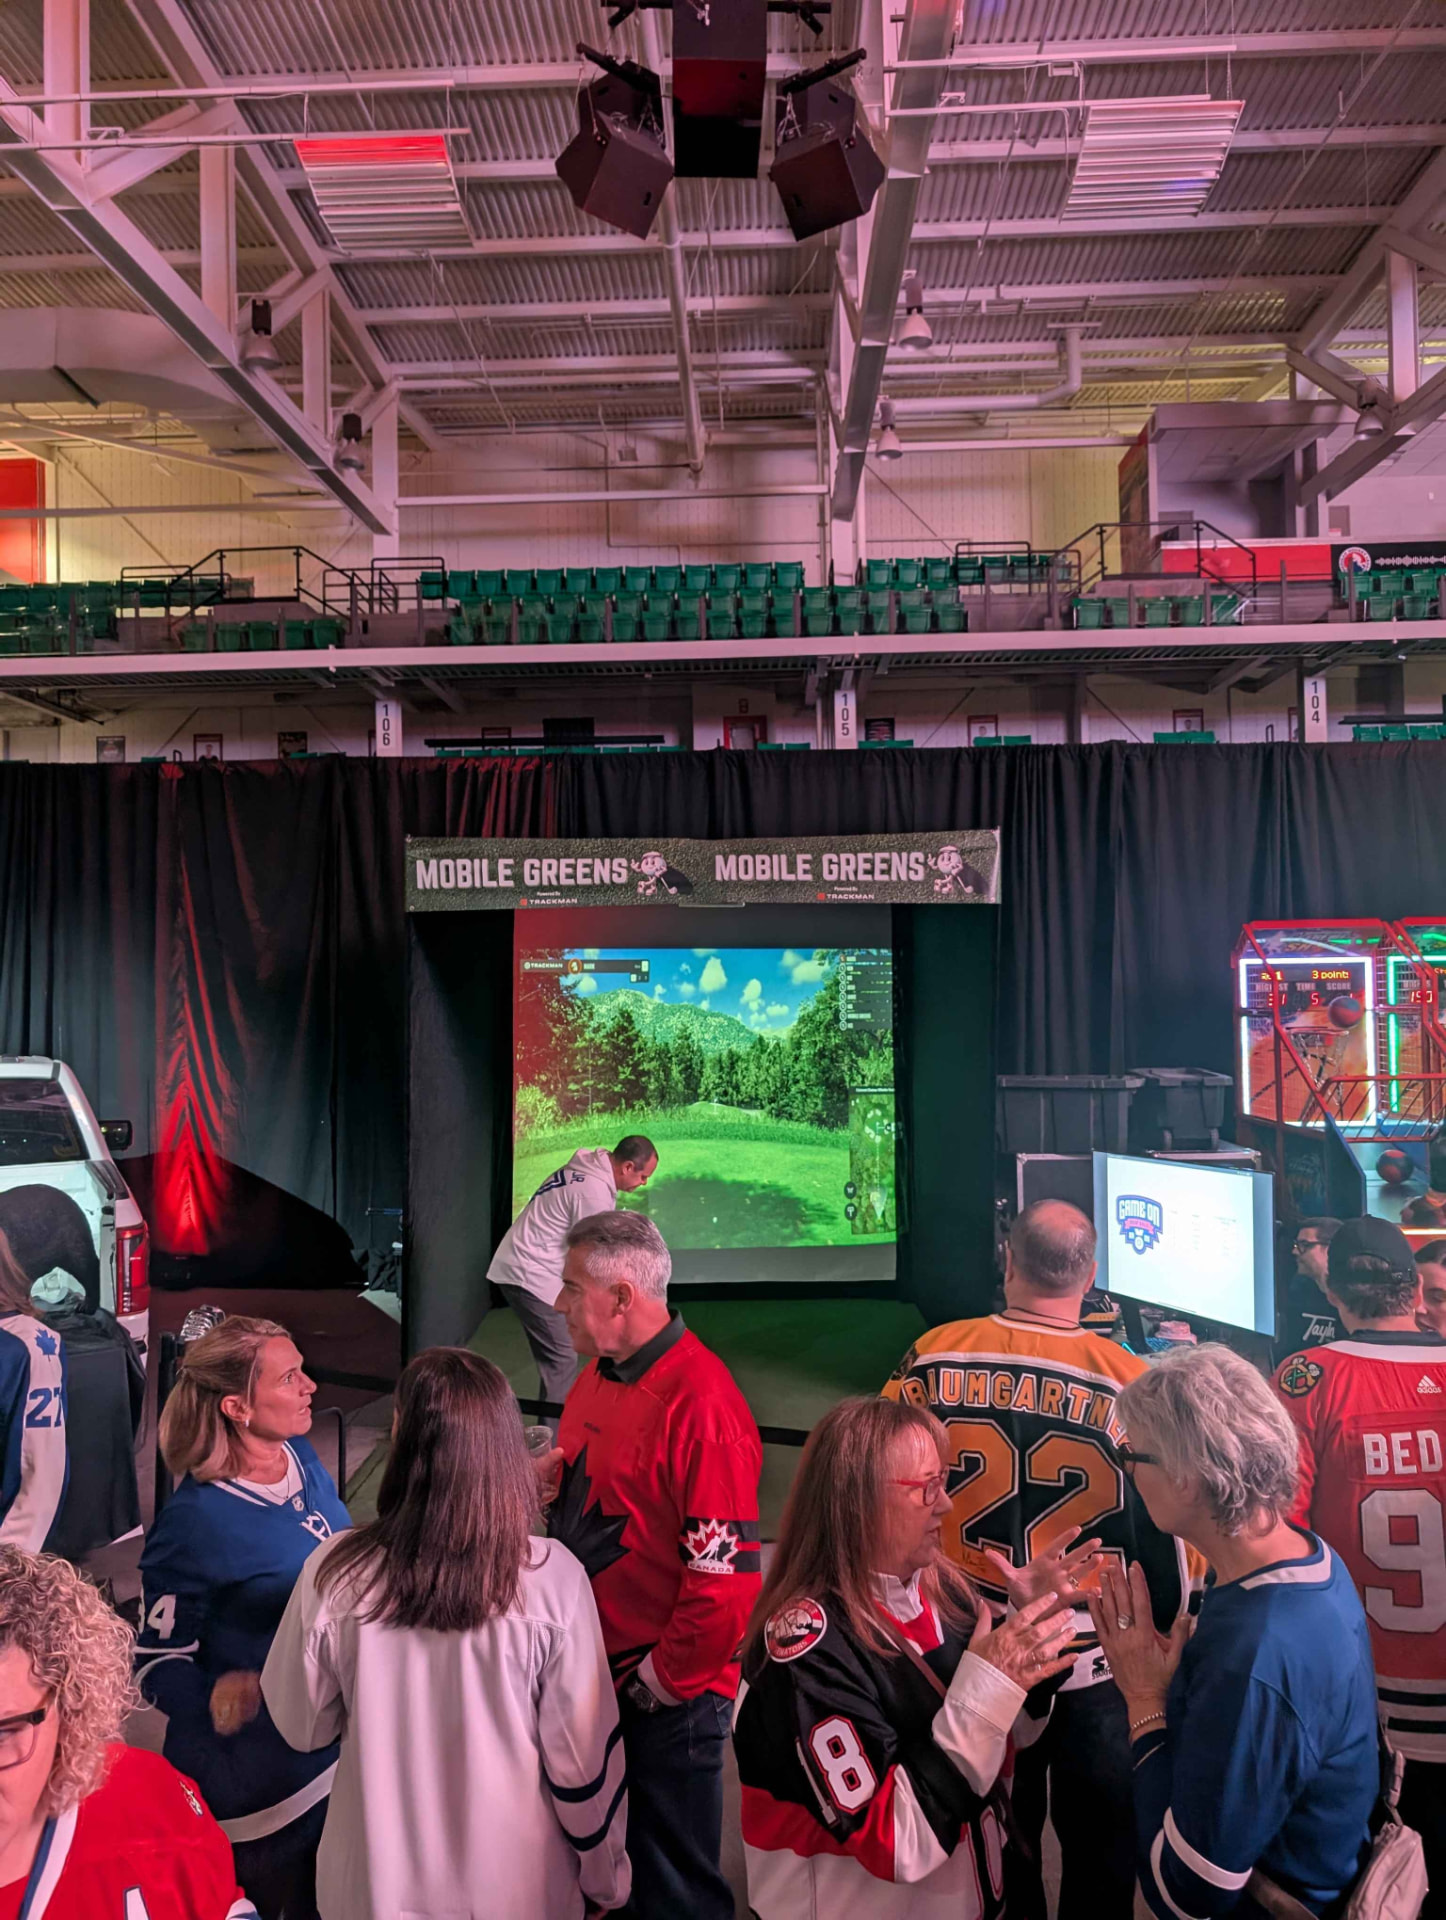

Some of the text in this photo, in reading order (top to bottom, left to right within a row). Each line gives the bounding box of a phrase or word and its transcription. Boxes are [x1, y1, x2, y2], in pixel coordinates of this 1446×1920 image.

[841, 693, 850, 736] 105
[1311, 681, 1320, 724] 104
[382, 703, 391, 746] 106
[416, 858, 628, 889] MOBILE GREENS
[715, 852, 924, 881] MOBILE GREENS
[1312, 970, 1319, 979] 3
[1119, 1199, 1146, 1219] GAME
[1147, 1203, 1160, 1228] ON
[25, 1387, 62, 1429] 27
[902, 1367, 1132, 1453] BAUMGARTNE
[1417, 1386, 1442, 1394] adidas
[1363, 1429, 1443, 1475] BED
[939, 1416, 1126, 1594] 22
[689, 1562, 732, 1573] CANADA
[1359, 1488, 1446, 1634] 9
